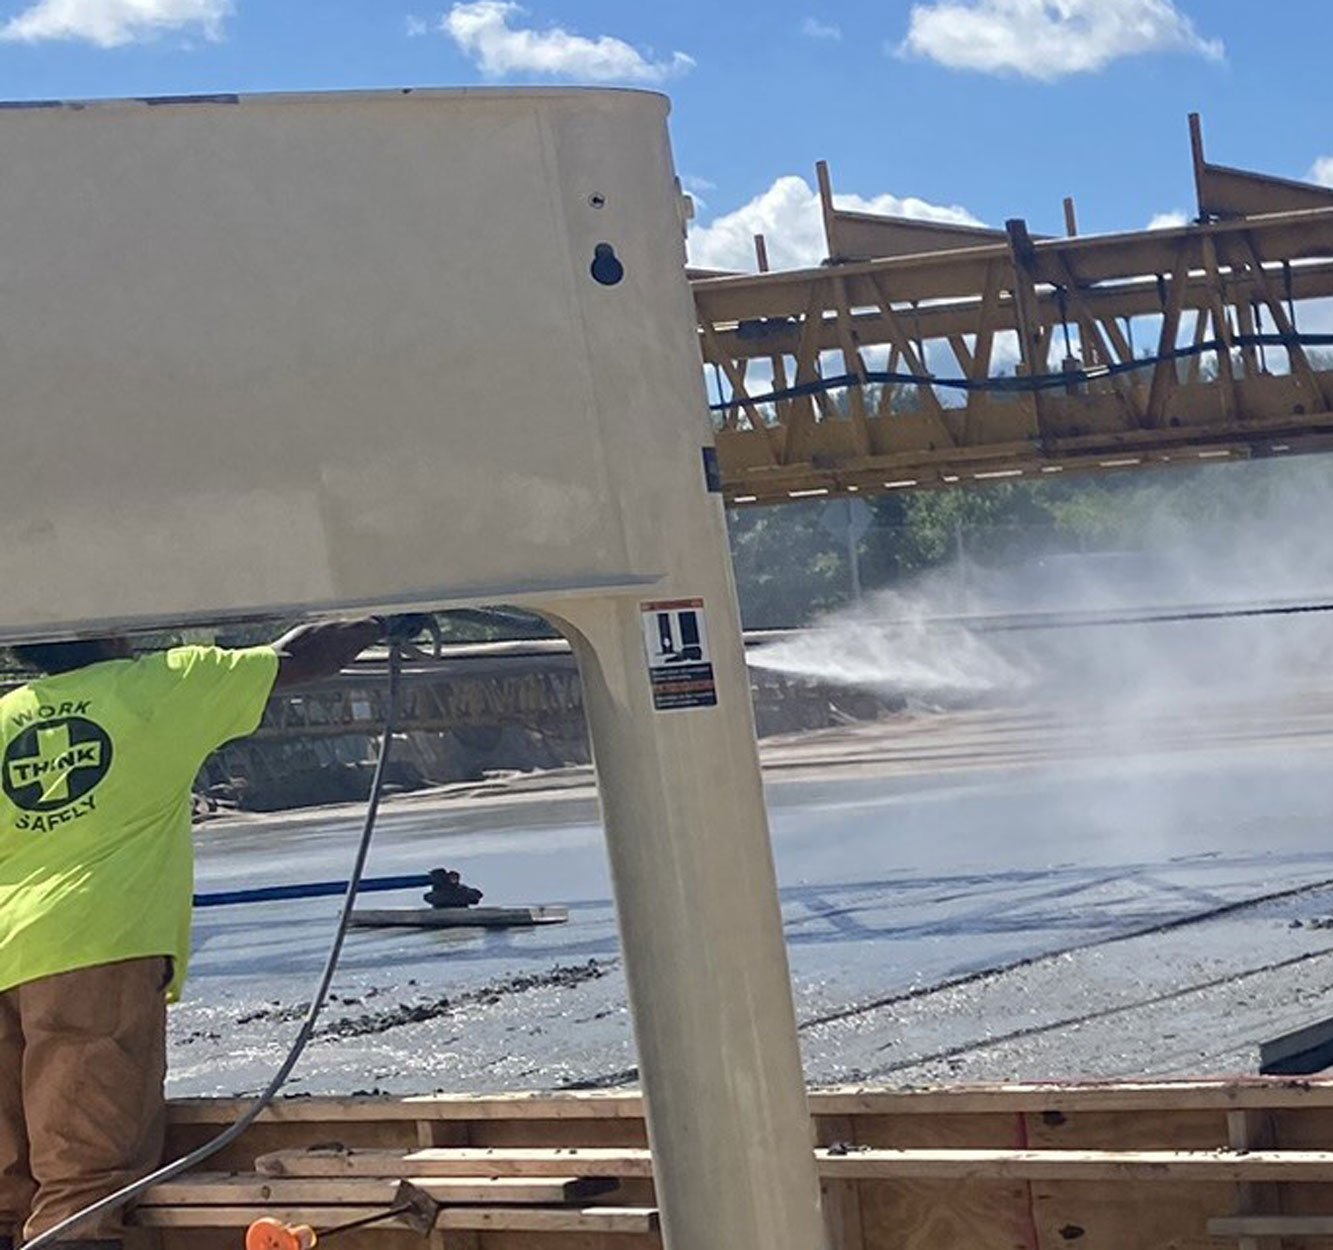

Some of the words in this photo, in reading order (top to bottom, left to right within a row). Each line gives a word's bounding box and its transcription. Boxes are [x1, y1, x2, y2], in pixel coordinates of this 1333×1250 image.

[12, 700, 91, 728] WORK
[13, 747, 96, 781] THINK
[15, 795, 97, 833] SAFELY
